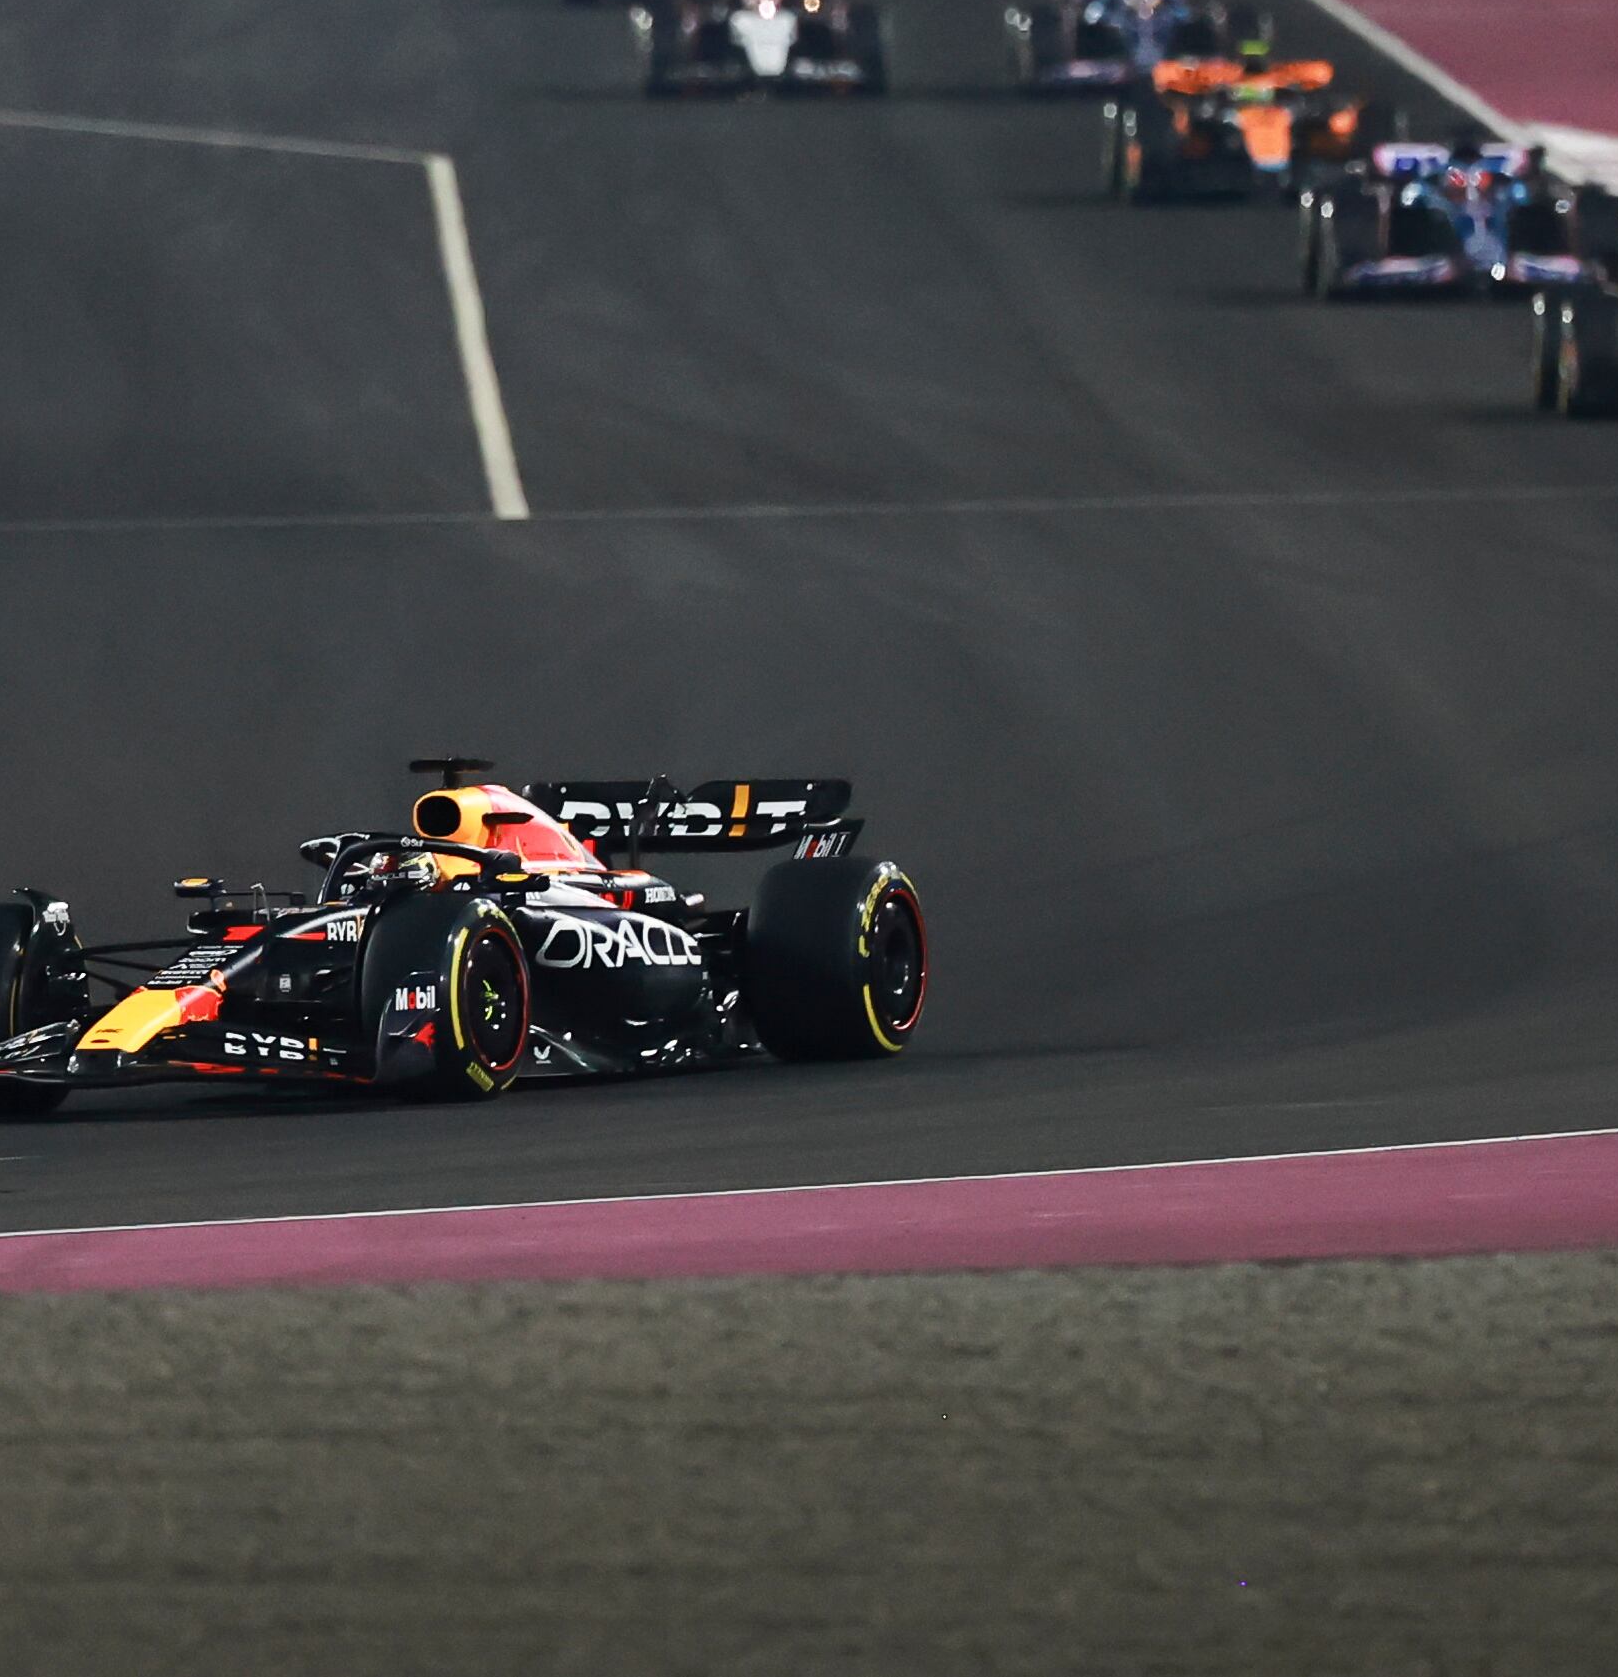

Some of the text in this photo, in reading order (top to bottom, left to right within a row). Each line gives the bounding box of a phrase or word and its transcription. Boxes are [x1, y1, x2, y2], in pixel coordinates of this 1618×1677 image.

[794, 833, 837, 860] Mobil
[645, 885, 676, 904] HONDA
[535, 918, 702, 969] ORACLE
[395, 985, 436, 1011] Mobil
